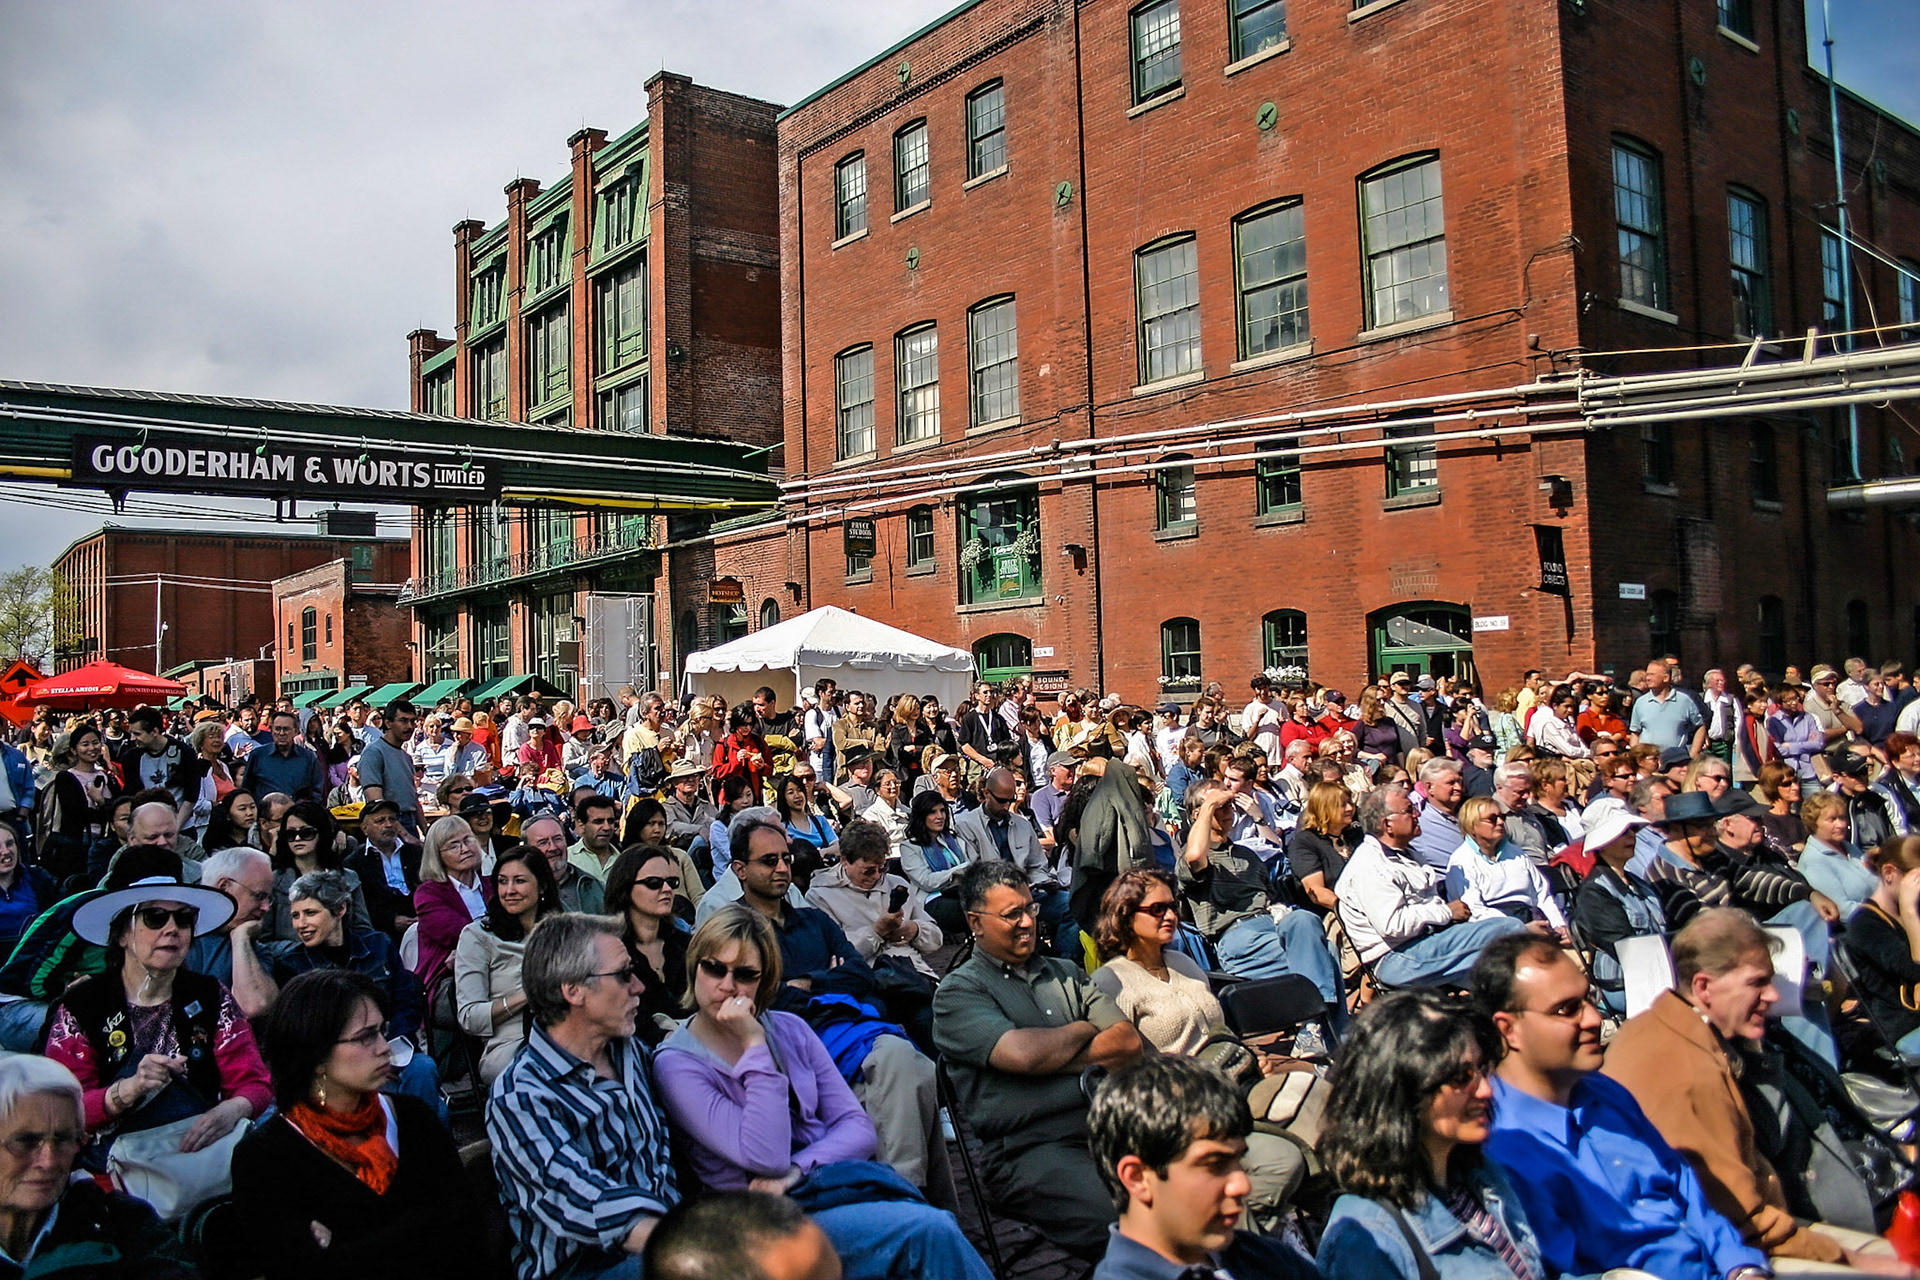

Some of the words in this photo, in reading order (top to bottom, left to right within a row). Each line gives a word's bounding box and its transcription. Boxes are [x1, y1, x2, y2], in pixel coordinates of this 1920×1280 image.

[92, 444, 295, 482] GOODERHAM
[304, 456, 329, 484] &
[332, 457, 430, 488] WORTS
[434, 467, 486, 485] LIMITED
[1543, 561, 1564, 573] FOUND
[1542, 573, 1566, 586] OBJECTS
[1034, 682, 1069, 690] DESIGNS
[1037, 676, 1065, 684] SOUND
